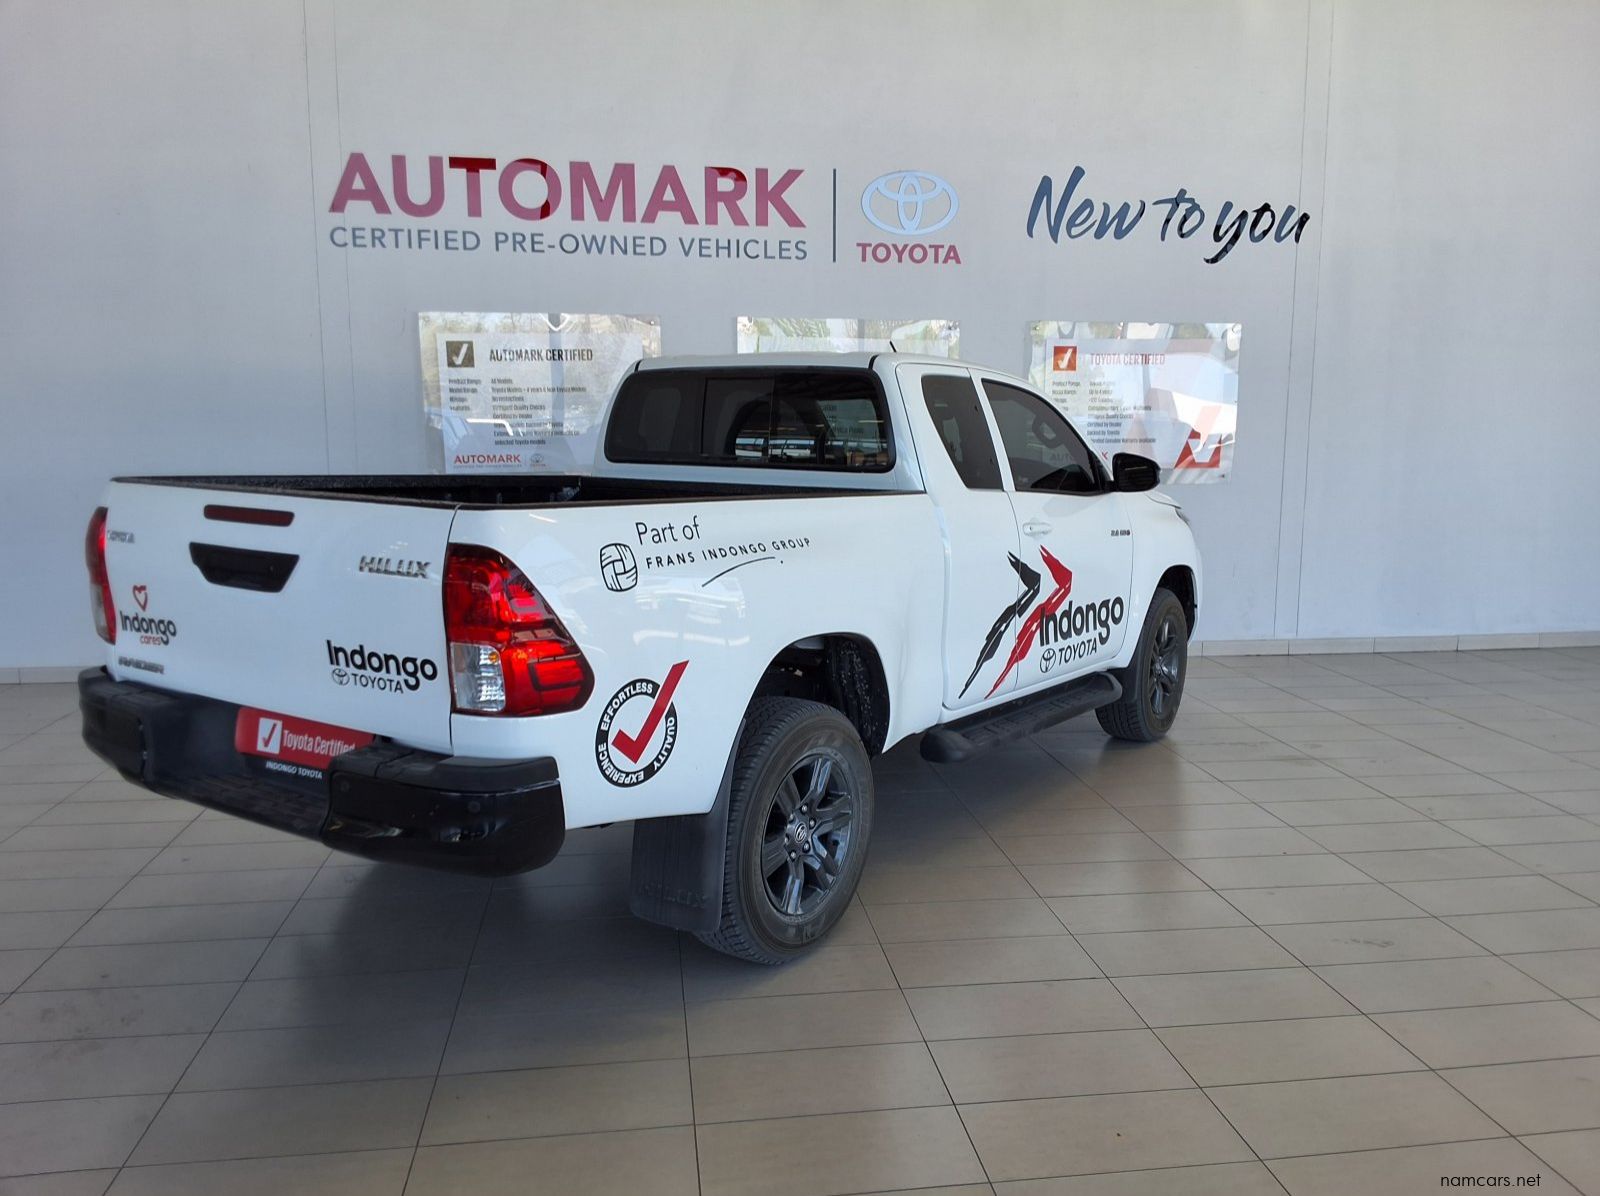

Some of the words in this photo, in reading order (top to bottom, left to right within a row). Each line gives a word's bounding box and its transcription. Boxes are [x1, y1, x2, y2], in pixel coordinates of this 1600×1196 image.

[329, 152, 806, 228] AUTOMARK
[1027, 166, 1145, 244] New
[1152, 188, 1205, 241] to
[1203, 201, 1310, 264] you
[329, 226, 480, 251] CERTIFIED
[495, 231, 667, 256] PRE-OWNED
[678, 236, 807, 261] VEHICLES
[856, 242, 962, 264] TOYOTA
[489, 349, 544, 362] AUTOMARK
[545, 348, 593, 362] CERTIFIED
[1090, 353, 1121, 366] TOYOTA
[1123, 353, 1165, 366] CERTIFIED
[454, 454, 521, 464] AUTOMARK
[635, 521, 678, 546] Part
[682, 515, 701, 540] of
[359, 555, 432, 580] HILUX
[646, 551, 695, 569] FRANS
[702, 542, 767, 561] INDONGO
[772, 537, 810, 551] GROUP
[120, 611, 177, 646] Indongo
[1039, 597, 1124, 647] Indongo
[140, 634, 162, 645] cares
[1058, 637, 1098, 666] TOYOTA
[326, 640, 438, 691] Indongo
[351, 673, 404, 694] TOYOTA
[600, 682, 653, 731] EFFORTLESS
[283, 730, 313, 752] Toyota
[653, 717, 675, 770] QUALITY
[266, 761, 297, 774] INDONGO
[298, 767, 323, 779] TOYOTA
[598, 742, 645, 784] EXPERIENCE
